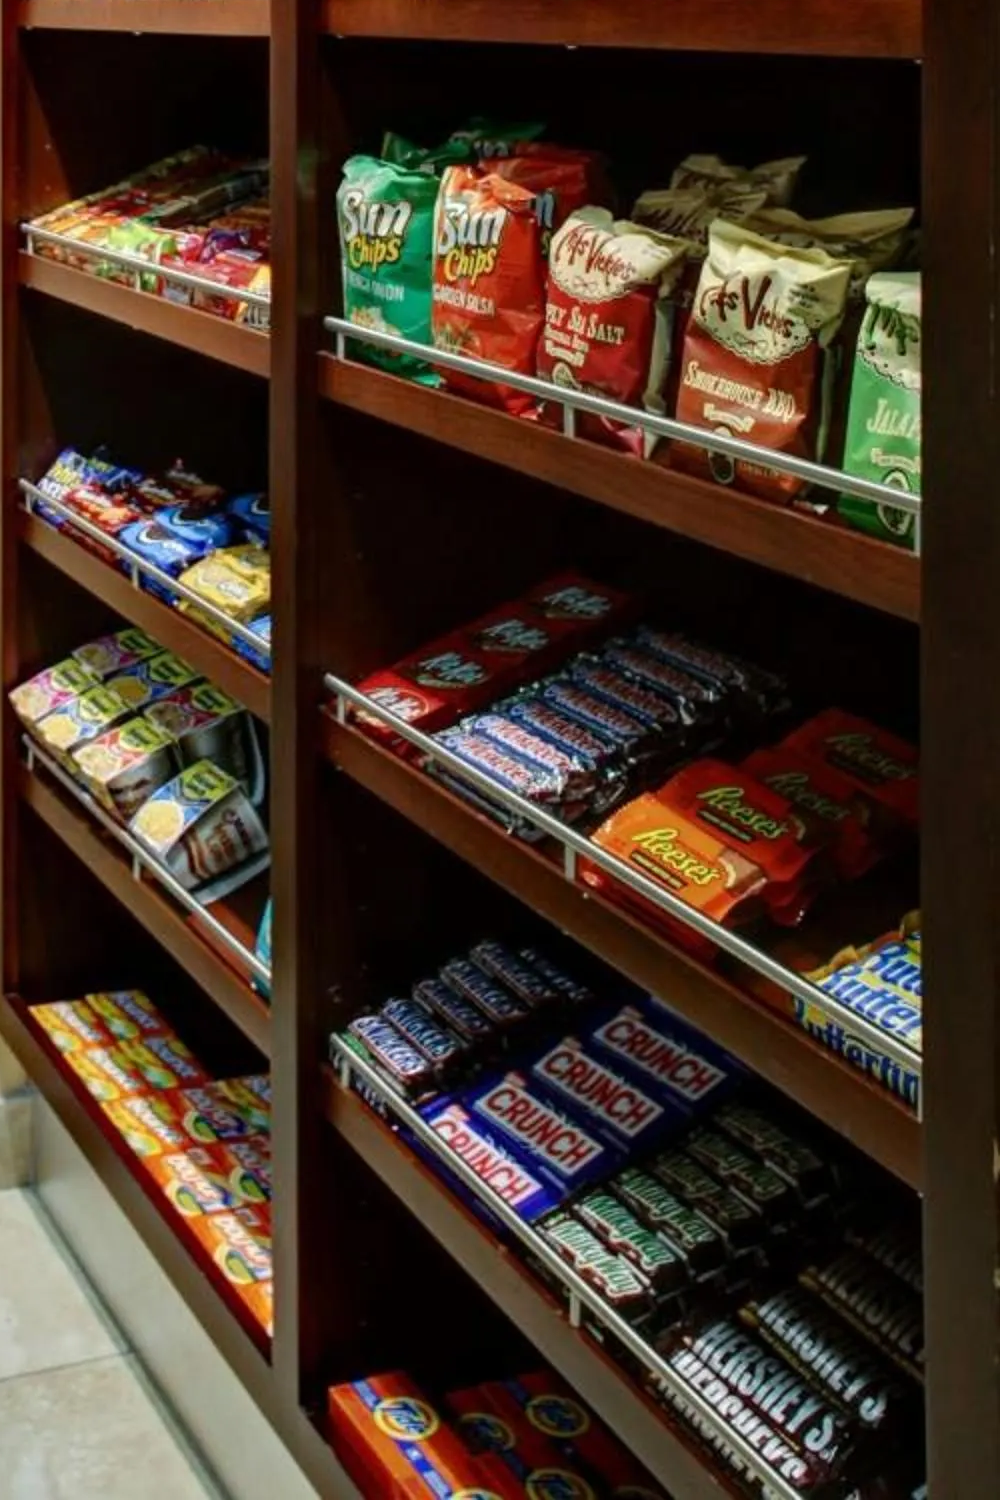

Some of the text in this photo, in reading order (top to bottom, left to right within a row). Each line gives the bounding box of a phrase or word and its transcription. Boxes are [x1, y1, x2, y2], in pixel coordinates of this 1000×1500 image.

[342, 190, 412, 242] Sun
[438, 201, 508, 255] Sun
[348, 236, 402, 272] Chips
[443, 248, 498, 286] Chips
[587, 313, 626, 345] SALT
[631, 828, 722, 886] Reese's
[604, 1019, 717, 1094] CRUNCH
[544, 1050, 653, 1130] CRUNCH
[486, 1087, 594, 1168] CRUNCH
[692, 1319, 836, 1453] HERSHEY'S
